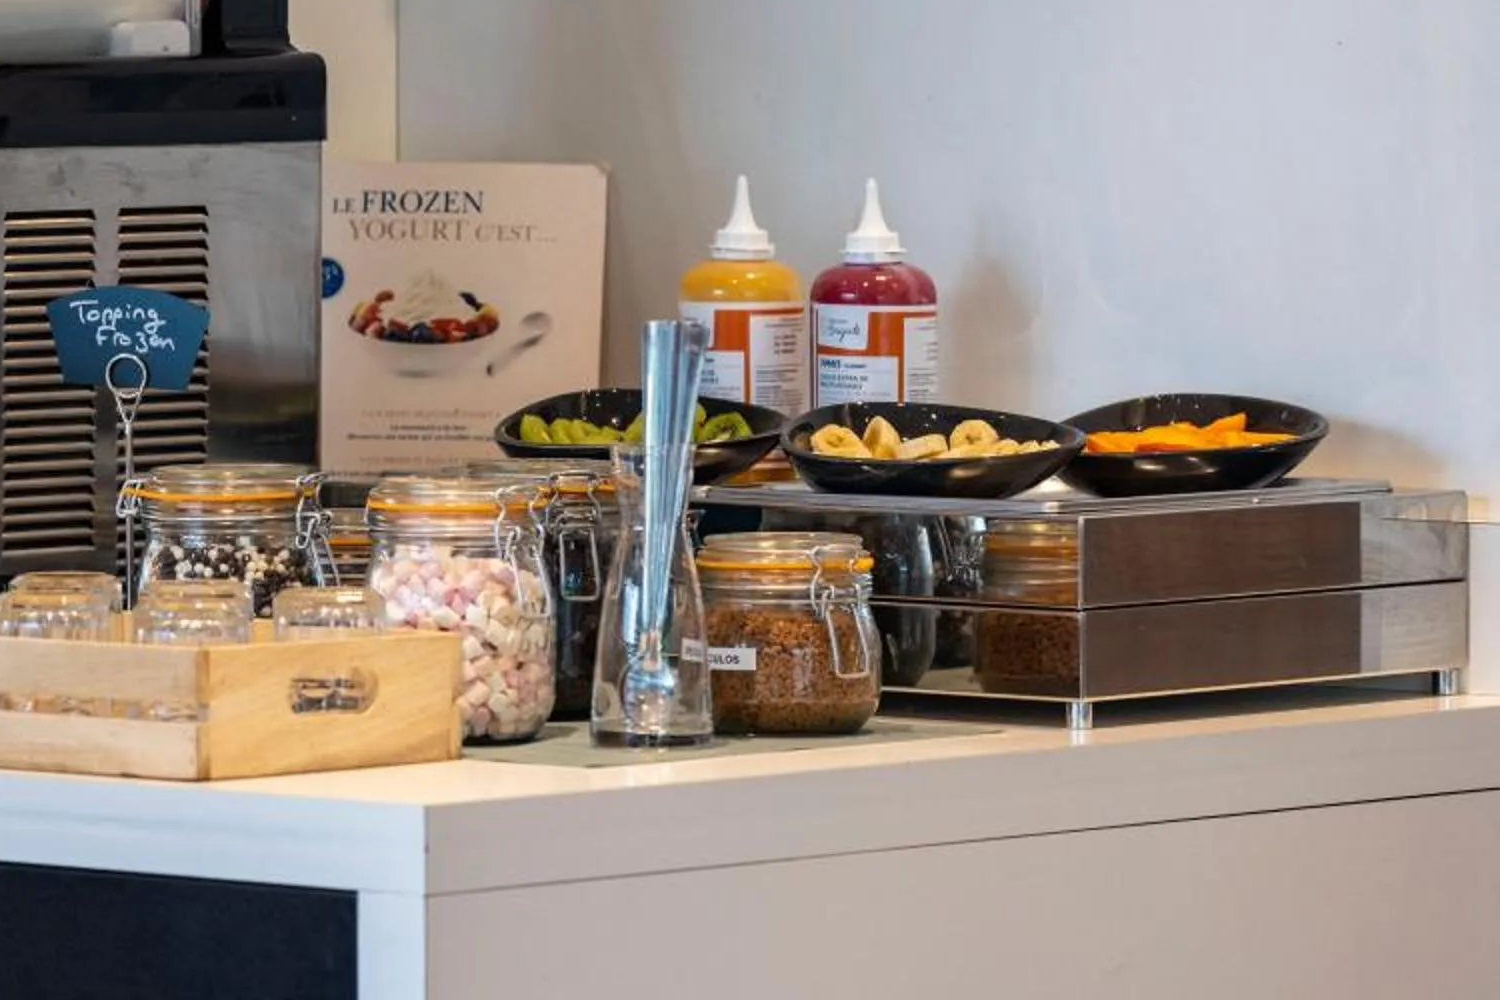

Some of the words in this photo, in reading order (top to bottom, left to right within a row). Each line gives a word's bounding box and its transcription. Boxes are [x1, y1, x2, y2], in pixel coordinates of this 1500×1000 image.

[362, 190, 484, 215] FROZEN
[350, 218, 470, 243] YOGURT
[69, 300, 166, 335] Topping
